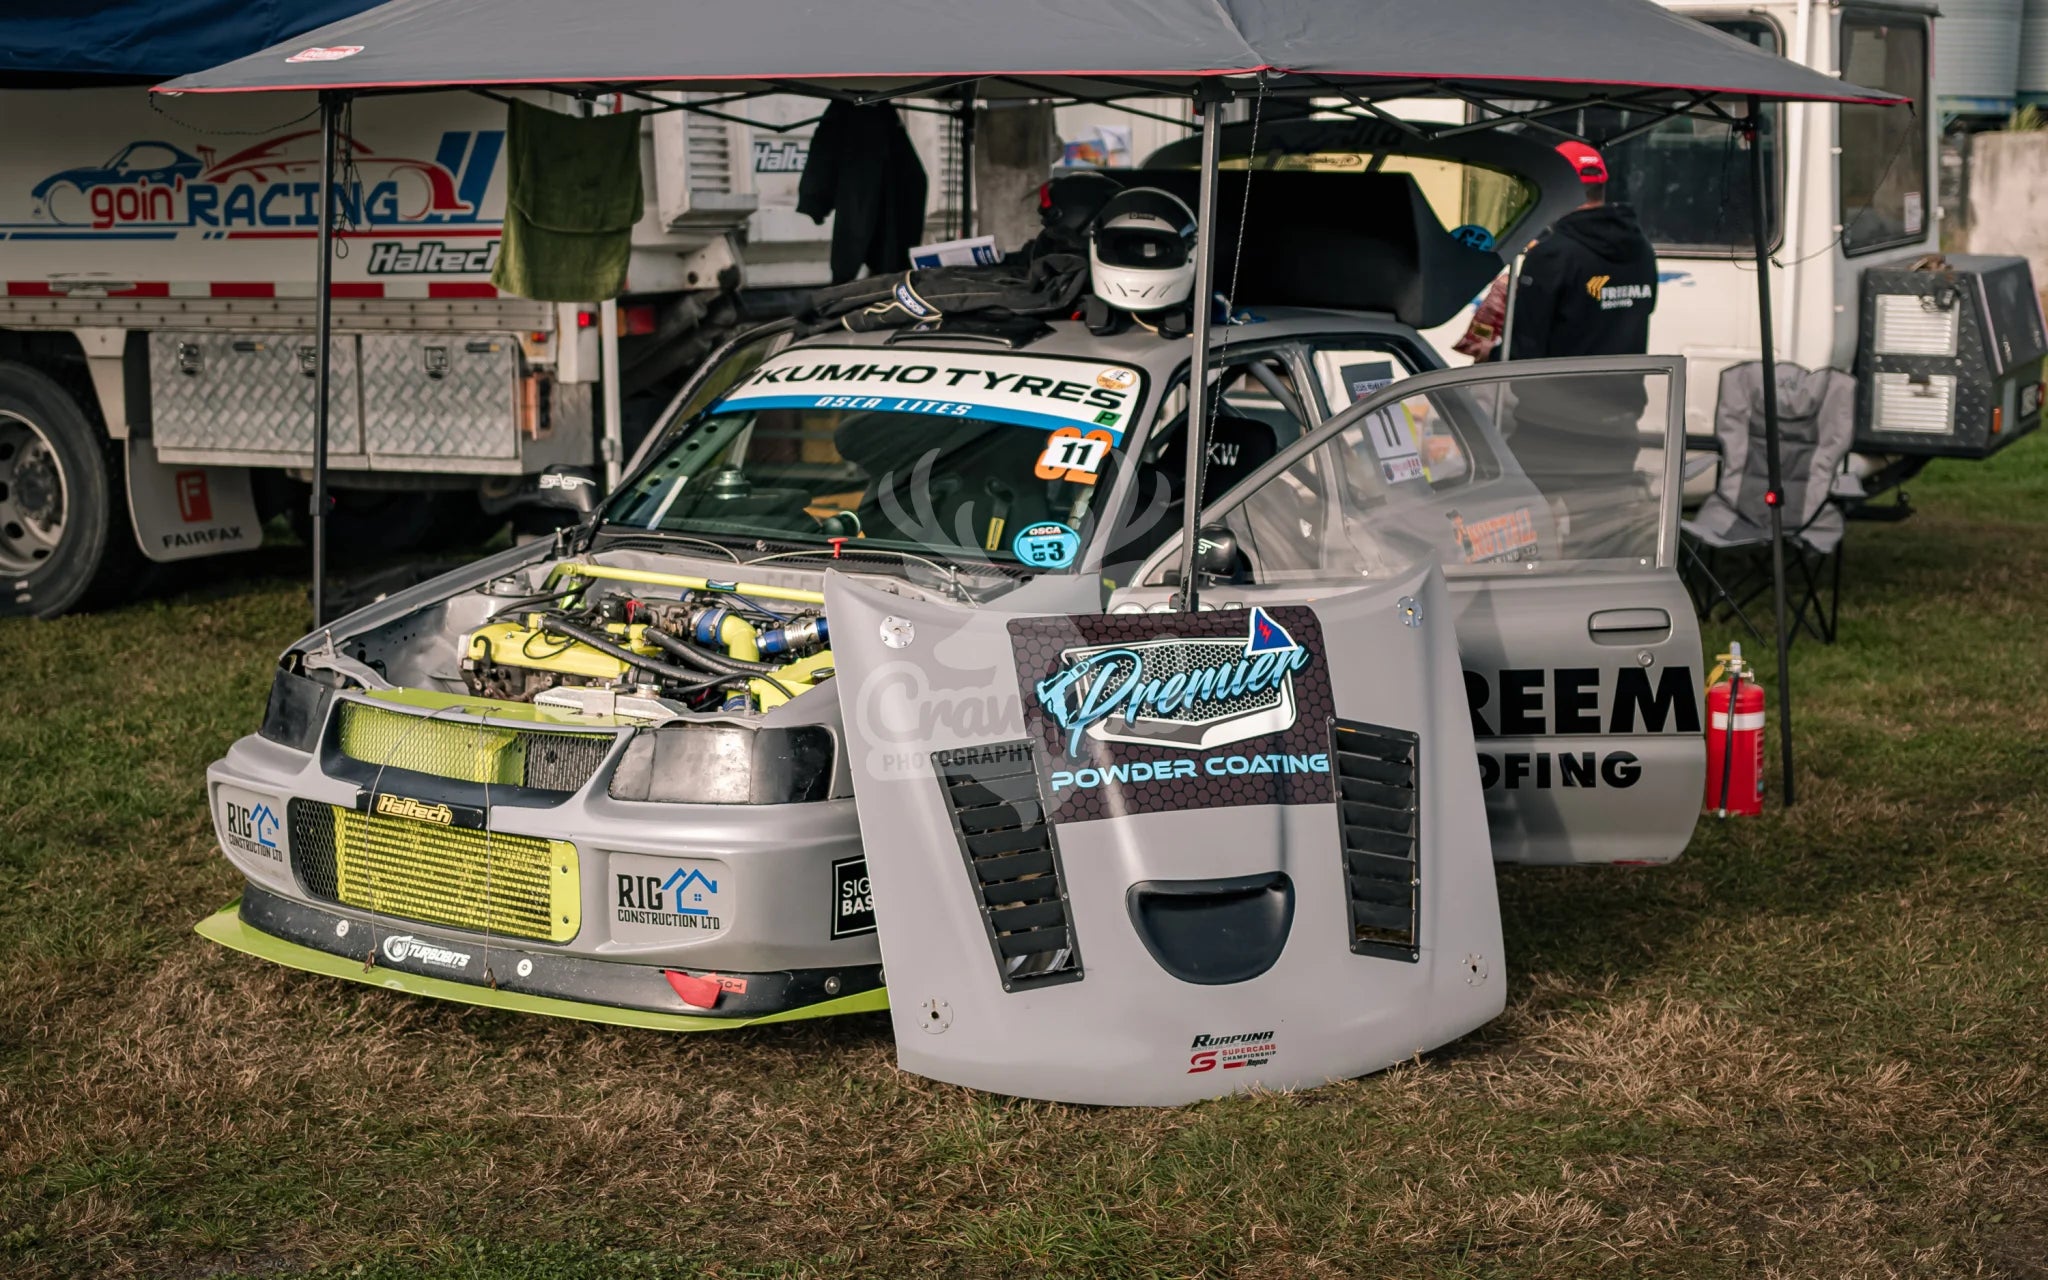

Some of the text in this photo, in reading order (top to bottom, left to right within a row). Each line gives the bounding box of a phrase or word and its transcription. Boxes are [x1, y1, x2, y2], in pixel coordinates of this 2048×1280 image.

[91, 175, 399, 229] goin' RACING
[753, 364, 938, 386] KUMHO
[938, 367, 1128, 410] TYRES
[815, 396, 973, 417] OSCA LITES
[1060, 441, 1094, 466] 11
[162, 526, 244, 549] FAIRFAX
[1028, 526, 1062, 536] OSCA
[1047, 541, 1065, 561] 3
[1066, 646, 1311, 758] Premier
[1051, 753, 1331, 791] POWDER COATING
[227, 801, 252, 839] RIG
[378, 794, 452, 825] Haltech
[228, 833, 283, 863] CONSTRUCTION LTD
[616, 873, 664, 911] RIG
[842, 877, 871, 899] SIG
[842, 894, 875, 917] BAS
[617, 908, 720, 930] CONSTRUCTION LTD
[408, 943, 471, 968] TURBOBITS
[1191, 1030, 1275, 1049] RUAPUNA
[1221, 1043, 1277, 1056] SUPERCARS
[1222, 1050, 1277, 1062] CHAMPIONSHIP
